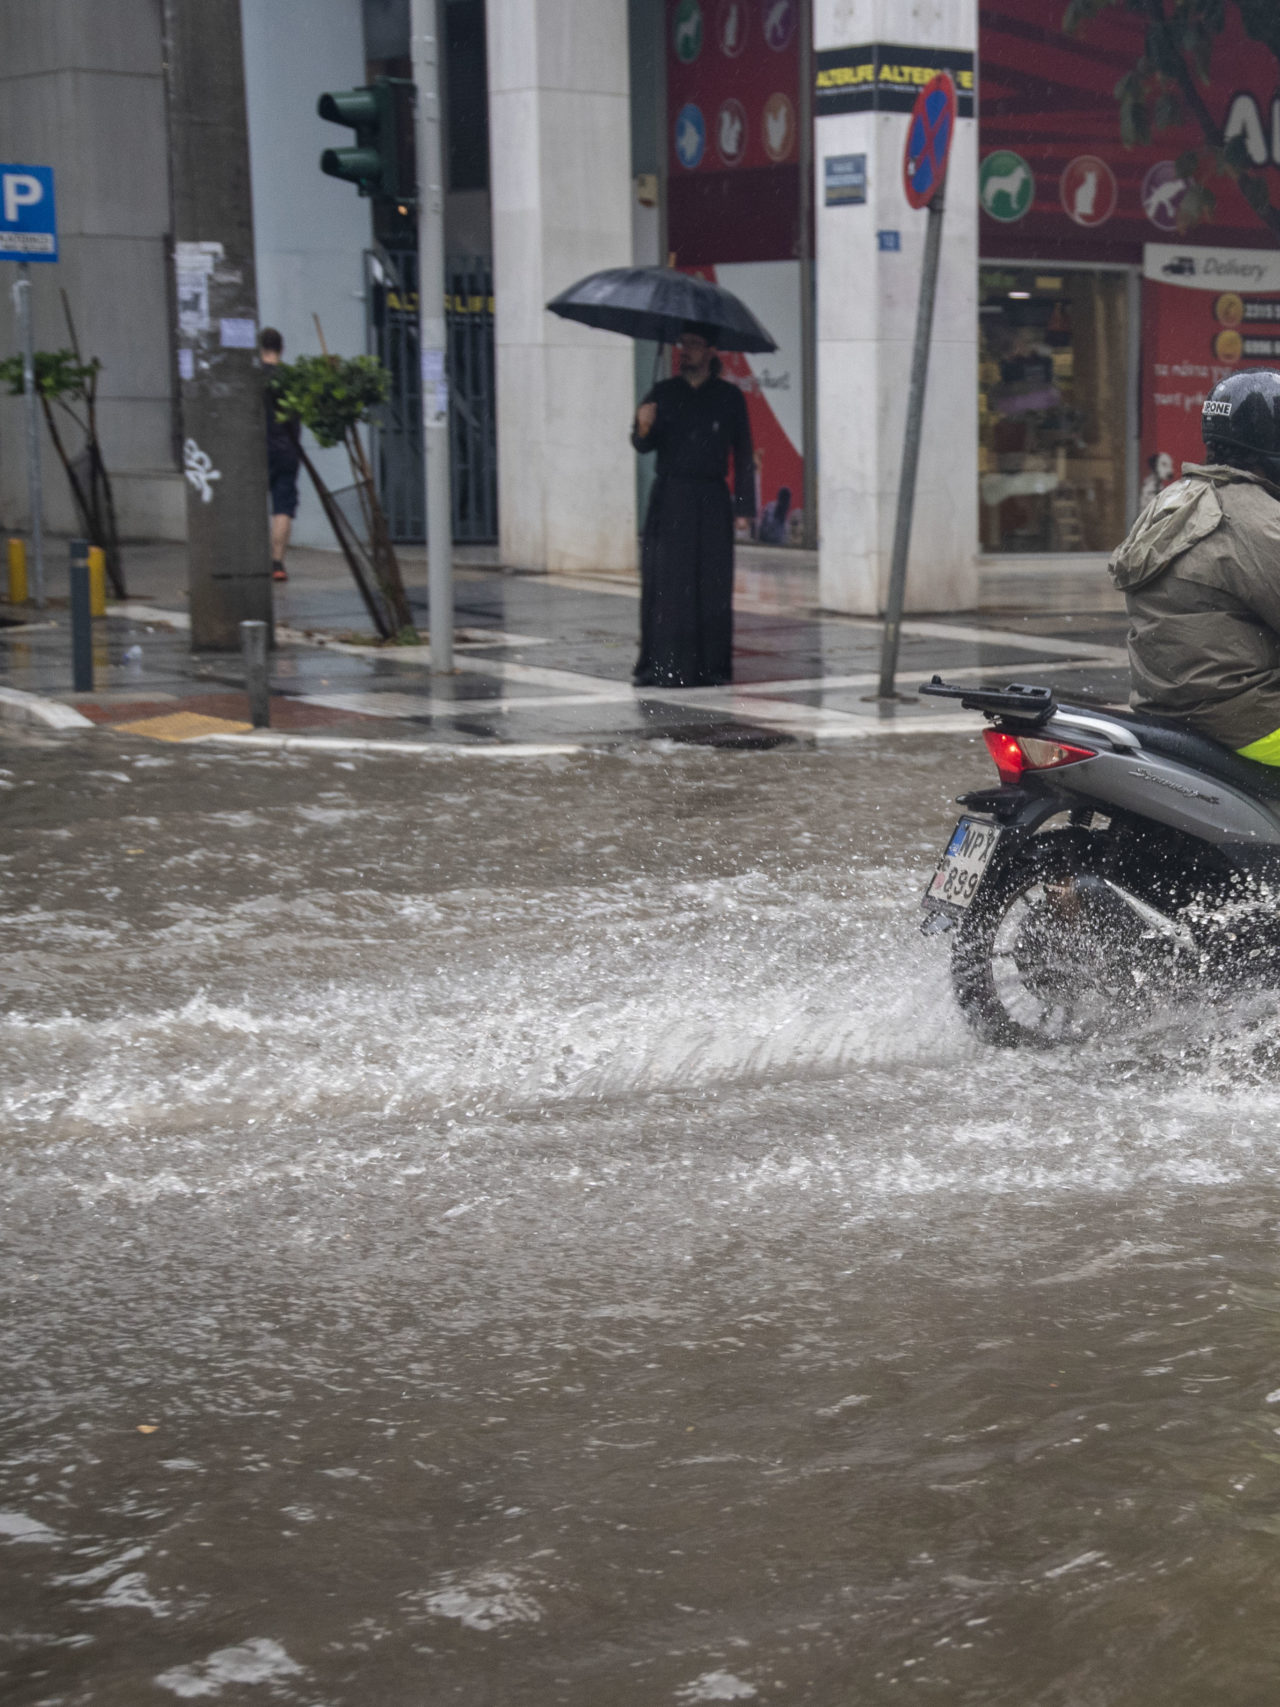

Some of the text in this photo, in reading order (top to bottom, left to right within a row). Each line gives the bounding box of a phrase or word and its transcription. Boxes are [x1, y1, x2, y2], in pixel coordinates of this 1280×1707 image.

[879, 64, 974, 89] ALTERFE
[3, 173, 43, 222] P
[1202, 256, 1267, 282] Delivery
[386, 292, 496, 314] ALTRLIFE
